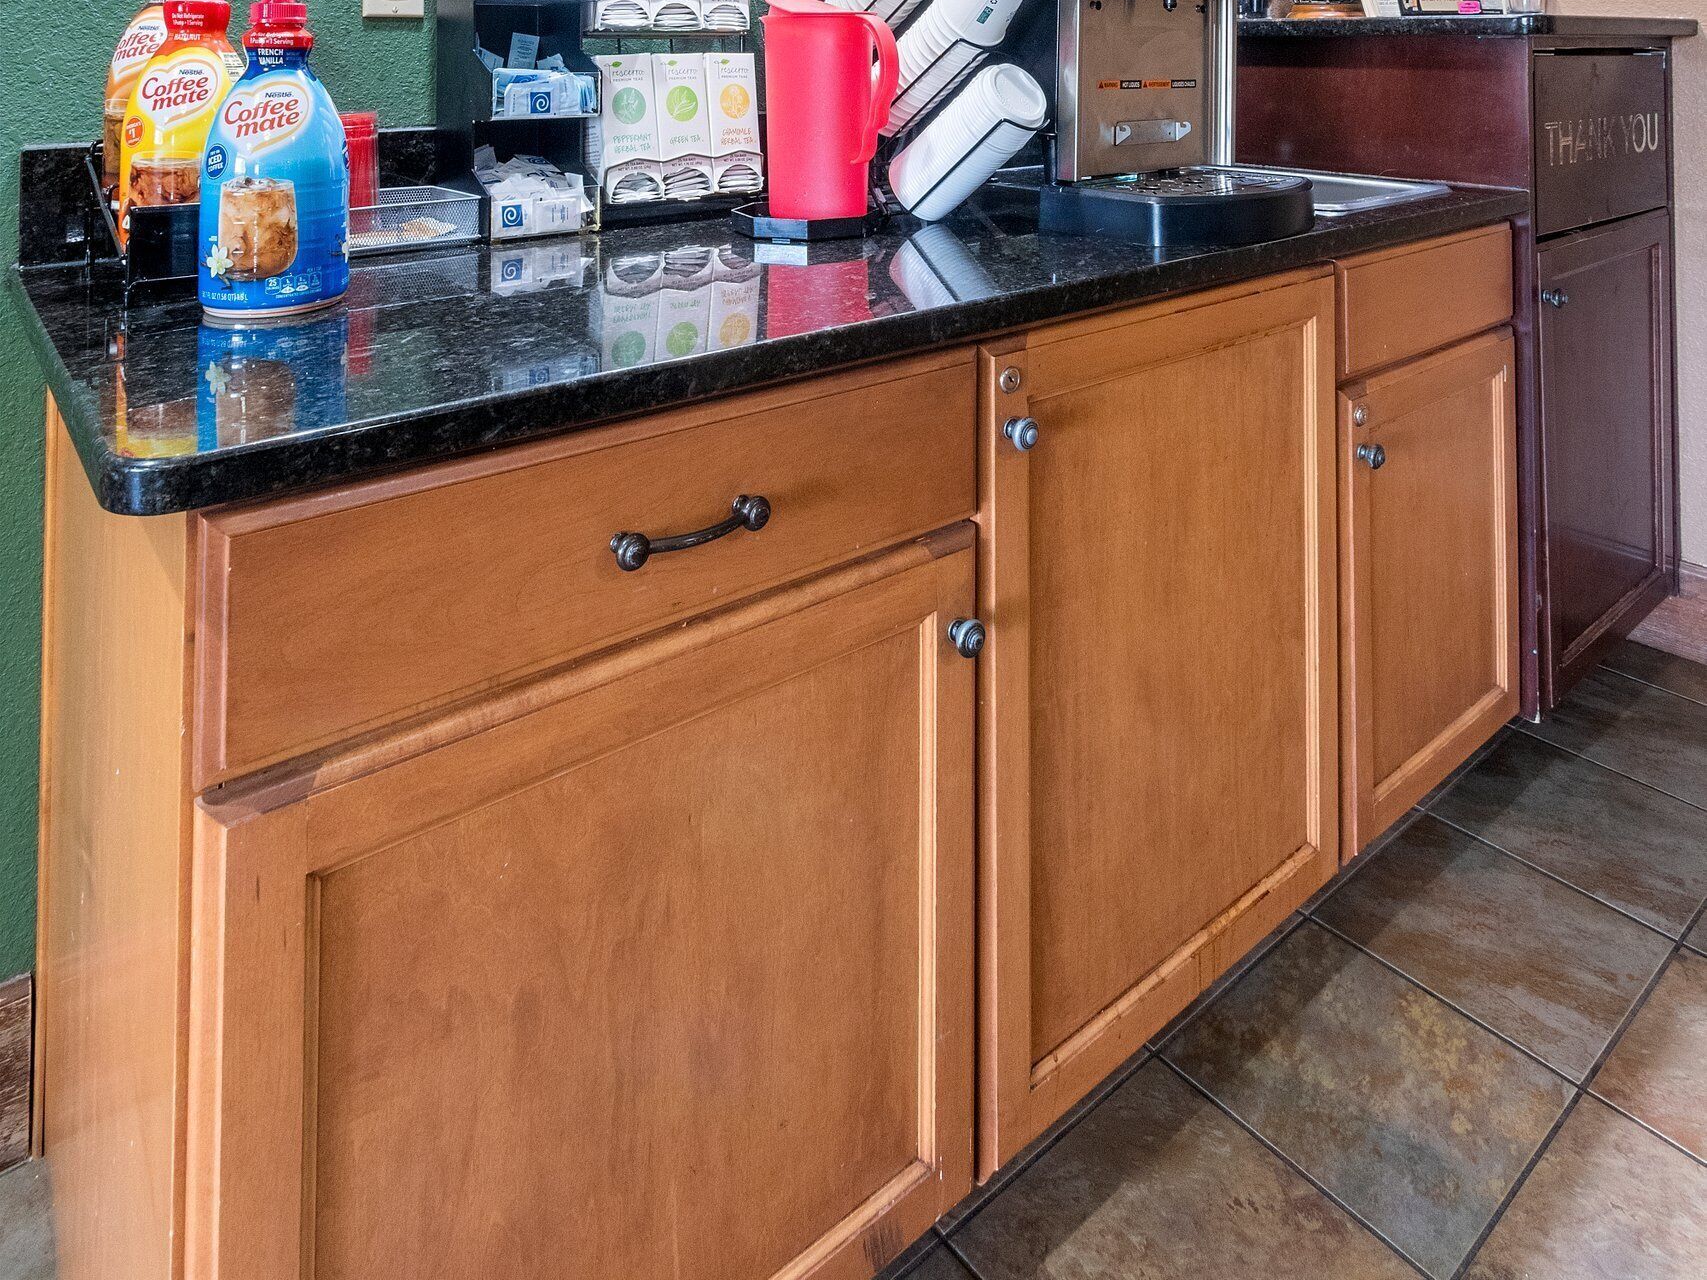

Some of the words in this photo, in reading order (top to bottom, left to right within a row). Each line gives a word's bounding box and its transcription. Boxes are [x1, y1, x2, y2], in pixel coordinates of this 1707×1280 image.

[116, 32, 157, 49] offee
[114, 43, 160, 63] mate
[142, 76, 208, 100] Coffee
[152, 88, 210, 112] mate
[224, 99, 299, 125] Coffee
[236, 112, 300, 138] mate
[722, 128, 752, 136] CHAMOMILE
[613, 134, 652, 144] PEPPERMINT
[670, 136, 689, 145] GREEN
[721, 137, 742, 145] HERBAL
[1544, 117, 1616, 166] THANK
[1620, 112, 1658, 154] YOU
[614, 146, 638, 154] HERBAL
[208, 154, 222, 165] ICED
[208, 162, 223, 172] COFFEE
